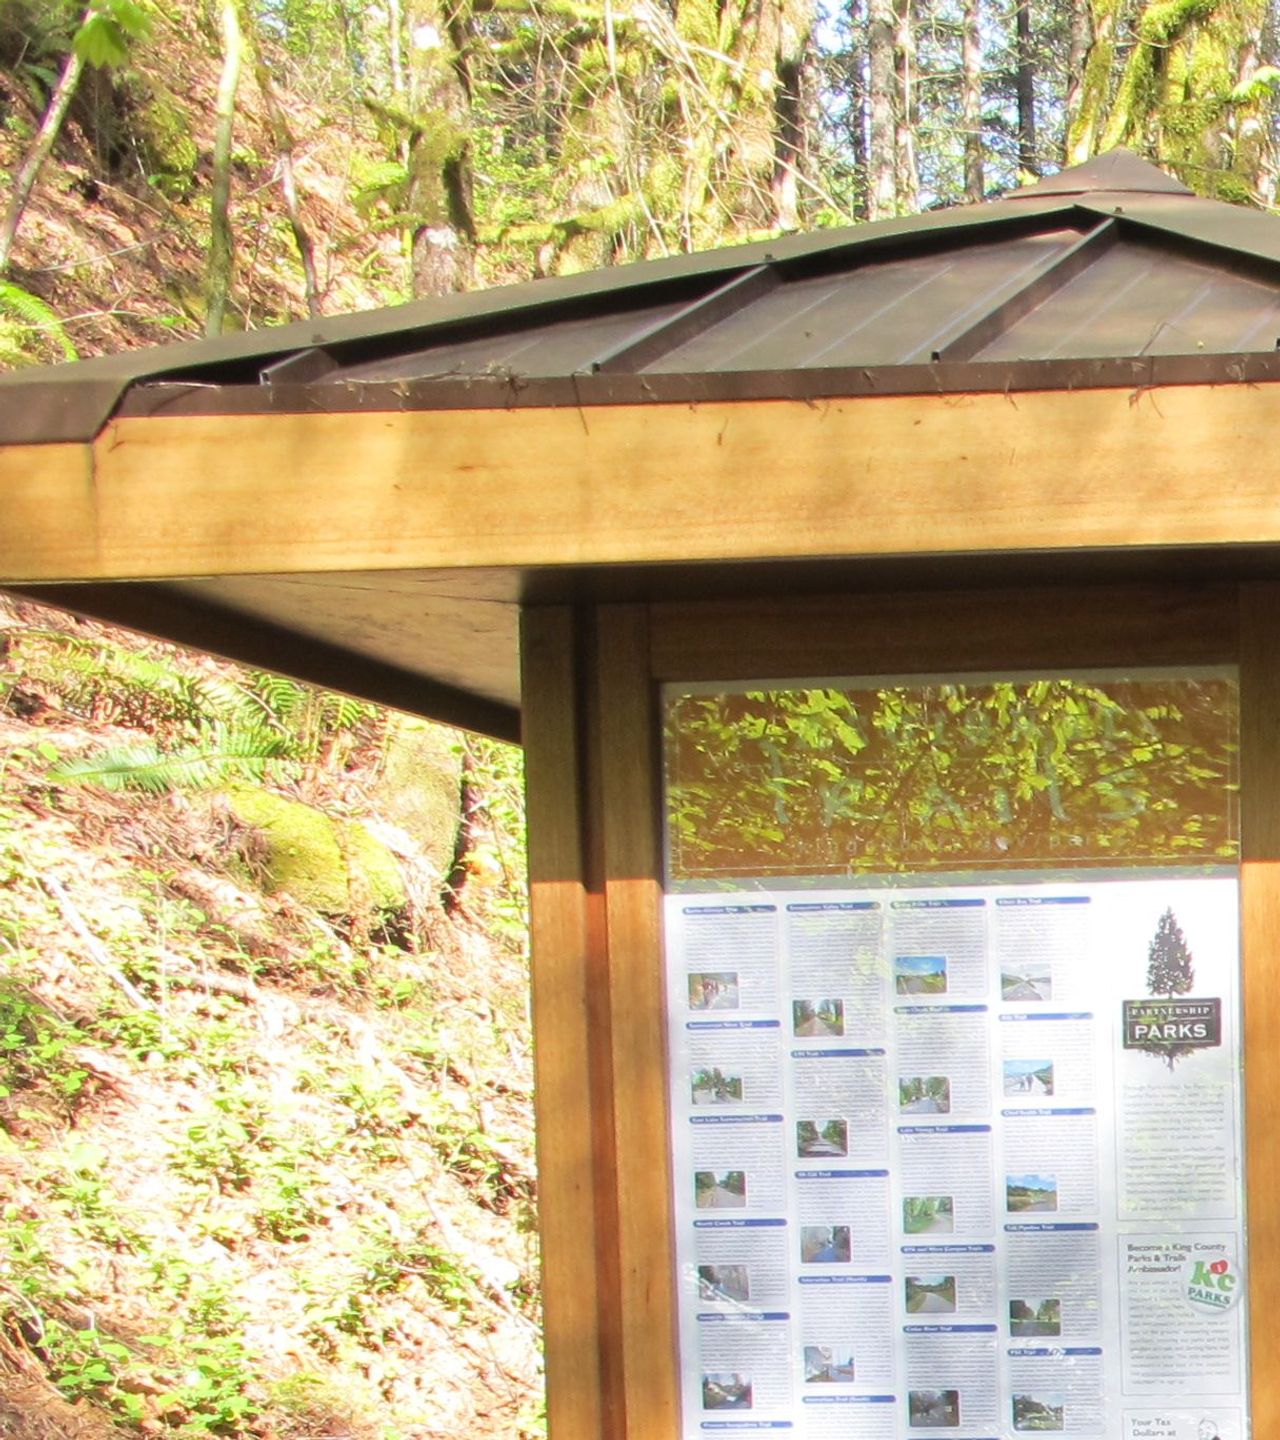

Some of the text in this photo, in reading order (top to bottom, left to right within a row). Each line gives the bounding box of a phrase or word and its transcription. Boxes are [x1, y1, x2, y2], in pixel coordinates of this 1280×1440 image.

[1132, 1006, 1211, 1016] PARTNERSHIP
[1135, 1024, 1208, 1040] PARKS
[1127, 1244, 1163, 1252] Become
[1172, 1243, 1192, 1253] King
[1194, 1243, 1226, 1252] County
[1127, 1255, 1152, 1263] Parks
[1164, 1254, 1187, 1262] Trails
[1187, 1287, 1231, 1305] PARKS
[1131, 1418, 1172, 1427] Your Tax
[1132, 1429, 1165, 1437] Dollars
